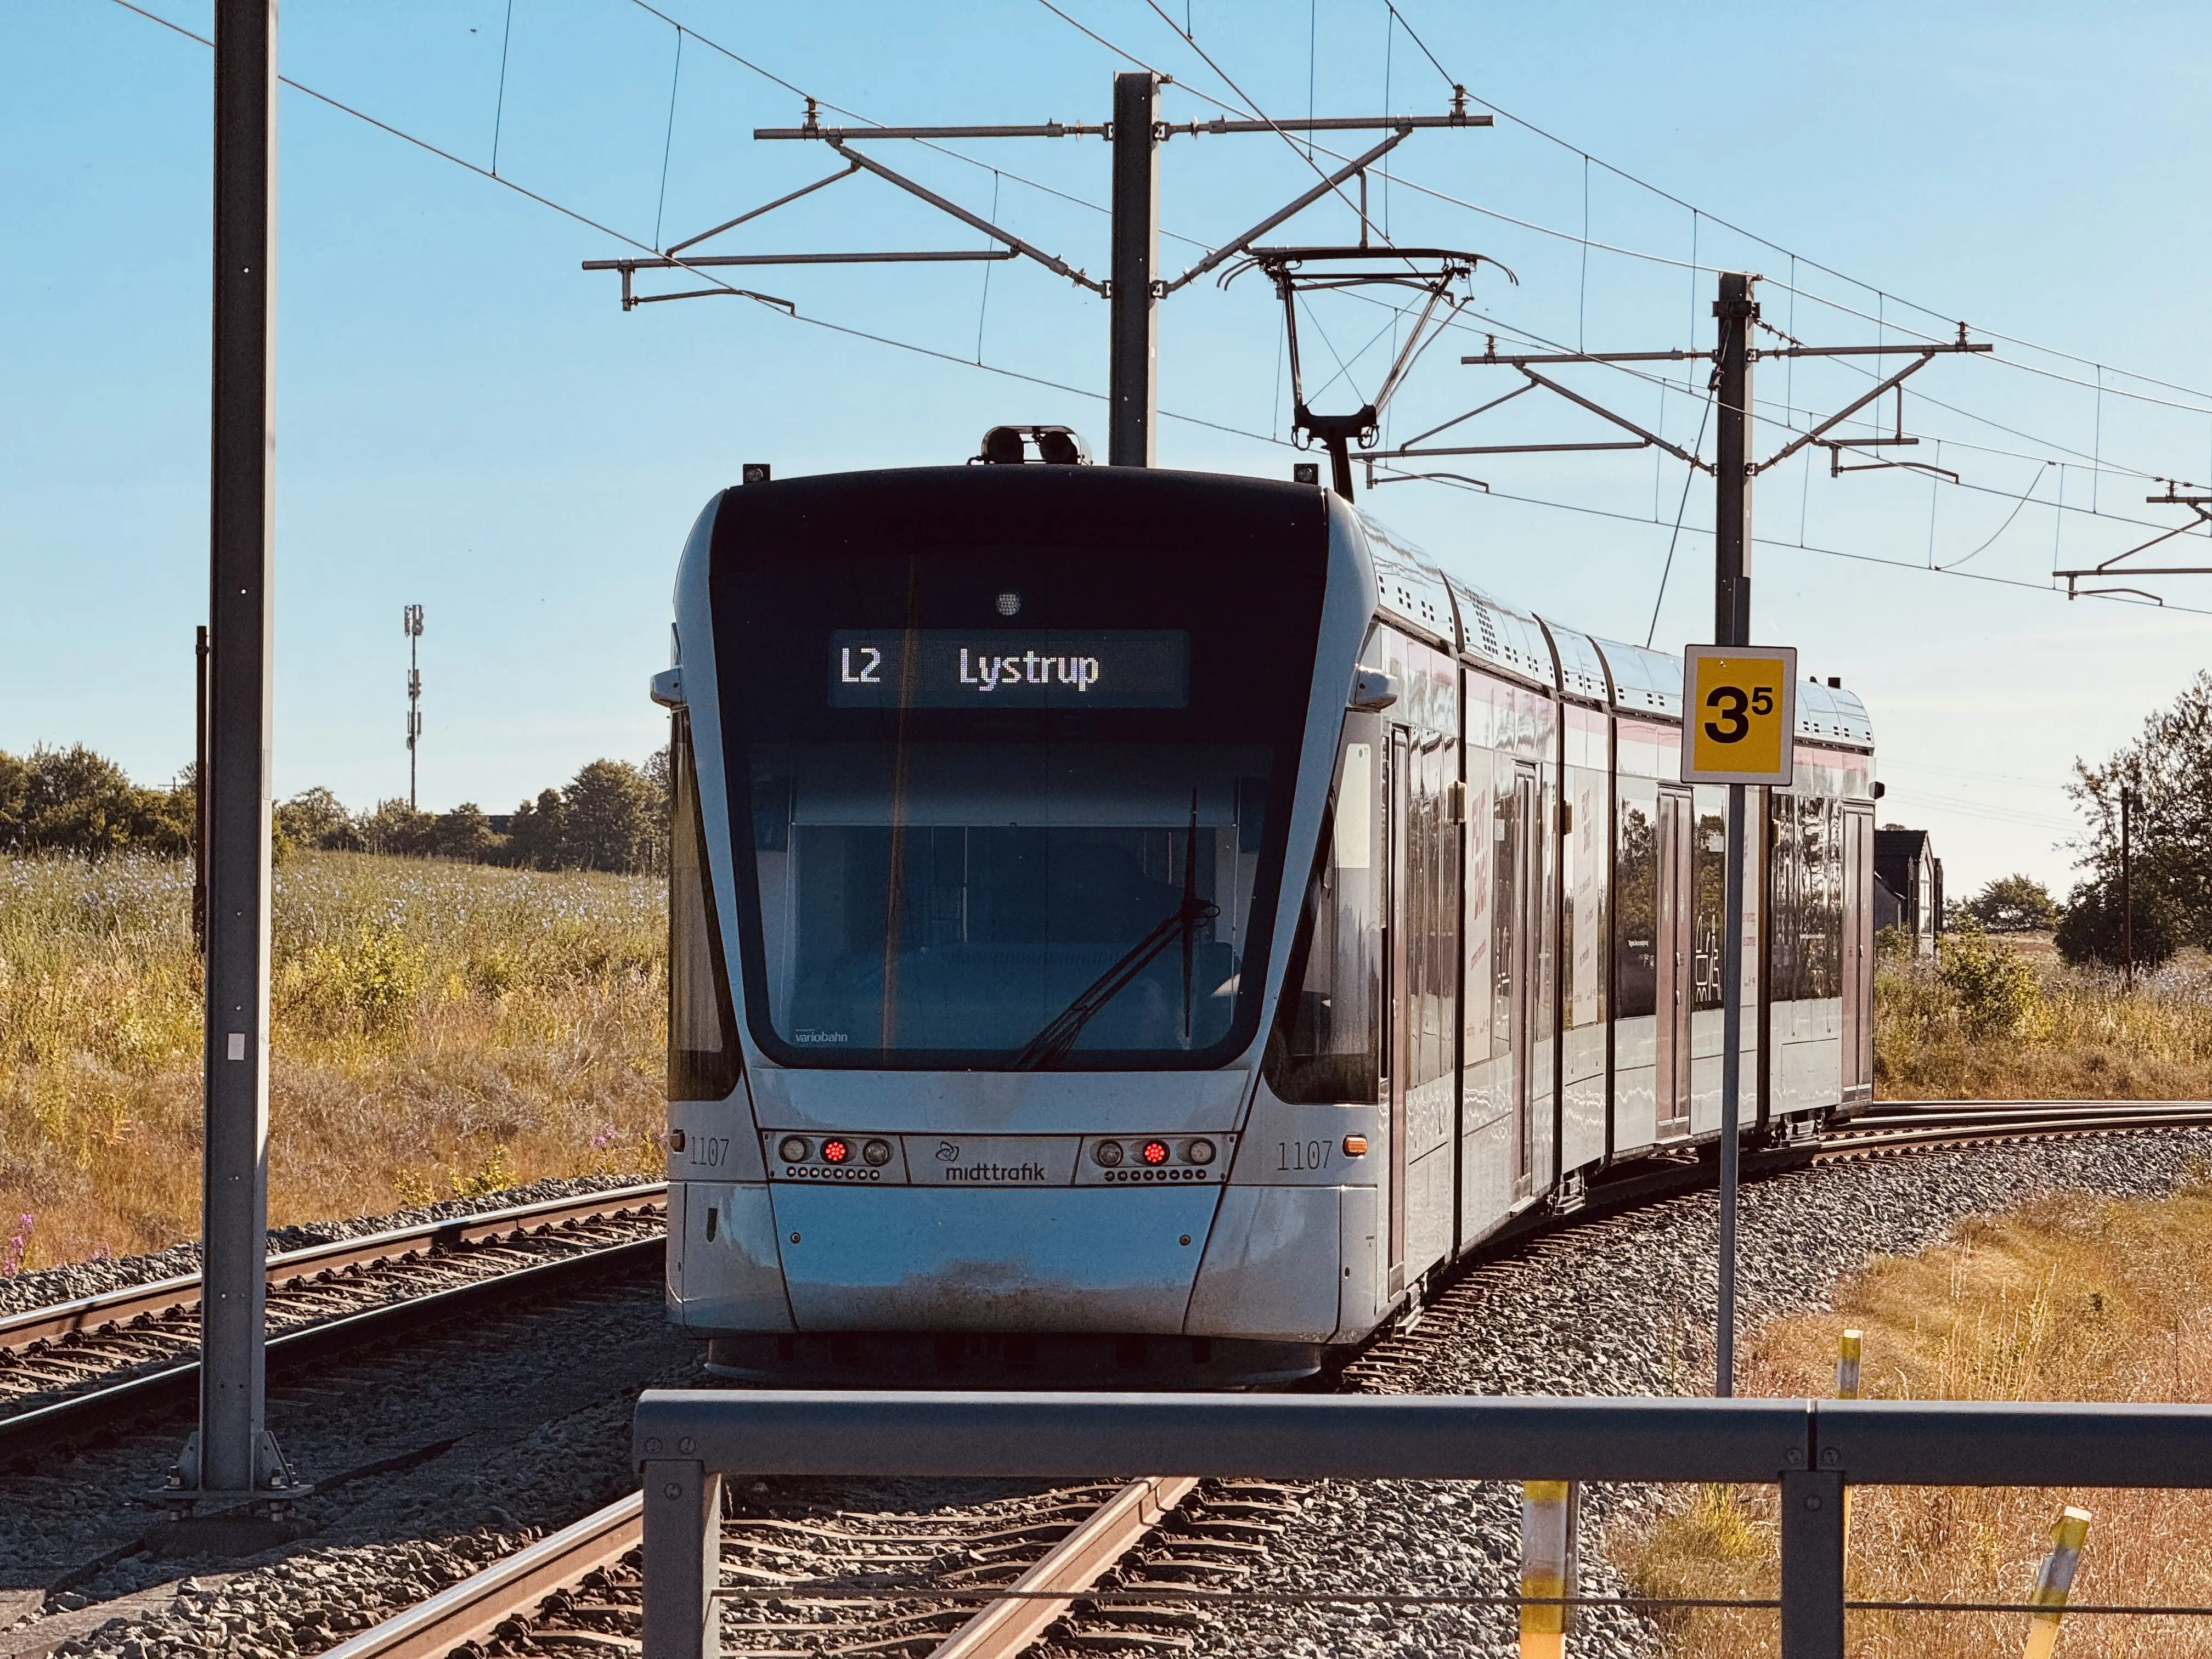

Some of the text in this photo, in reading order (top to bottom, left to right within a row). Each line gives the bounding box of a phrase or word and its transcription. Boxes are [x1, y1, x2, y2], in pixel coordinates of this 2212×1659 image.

[840, 648, 1099, 692] L2 Lystrup
[795, 1031, 848, 1042] variobahn
[690, 1136, 730, 1167] 1107
[1277, 1141, 1333, 1171] 1107
[946, 1163, 1045, 1181] midttrafik
